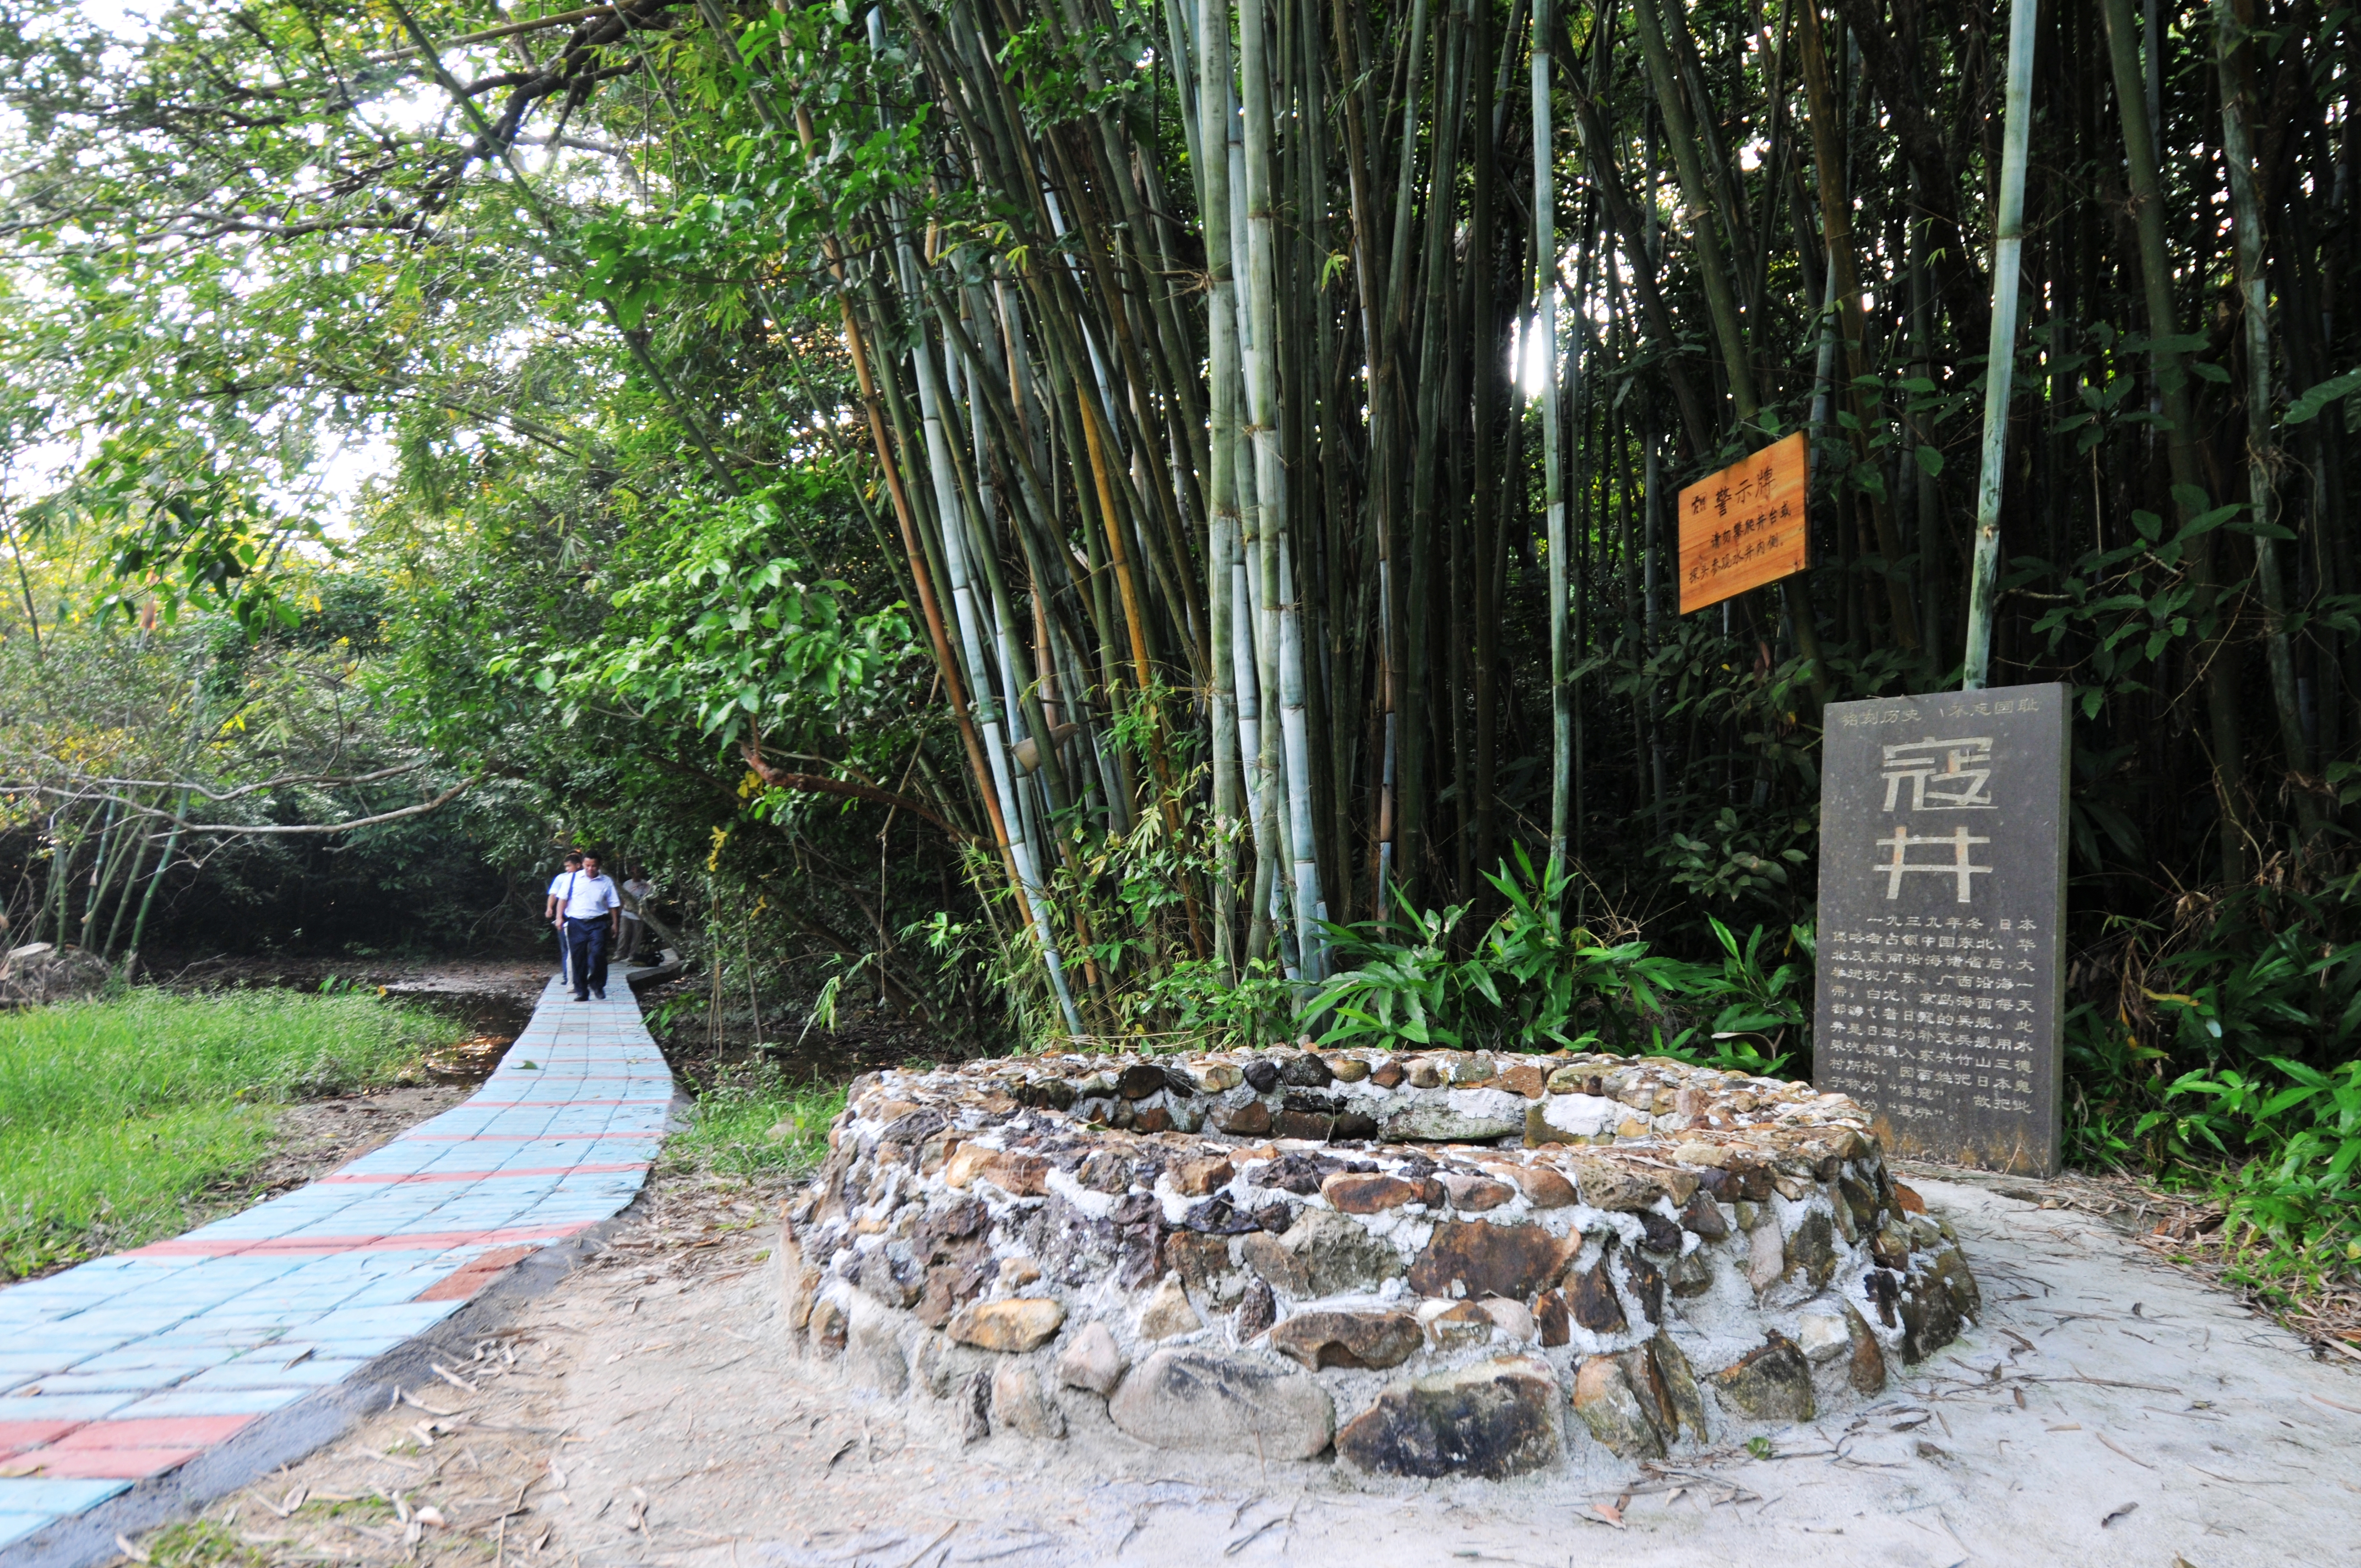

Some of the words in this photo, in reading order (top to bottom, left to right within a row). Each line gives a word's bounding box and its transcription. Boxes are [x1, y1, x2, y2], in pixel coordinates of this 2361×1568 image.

[1715, 466, 1776, 517] 警示牌
[1711, 500, 1791, 549] 请勿攀爬井台或
[1874, 736, 1999, 903] 寇井
